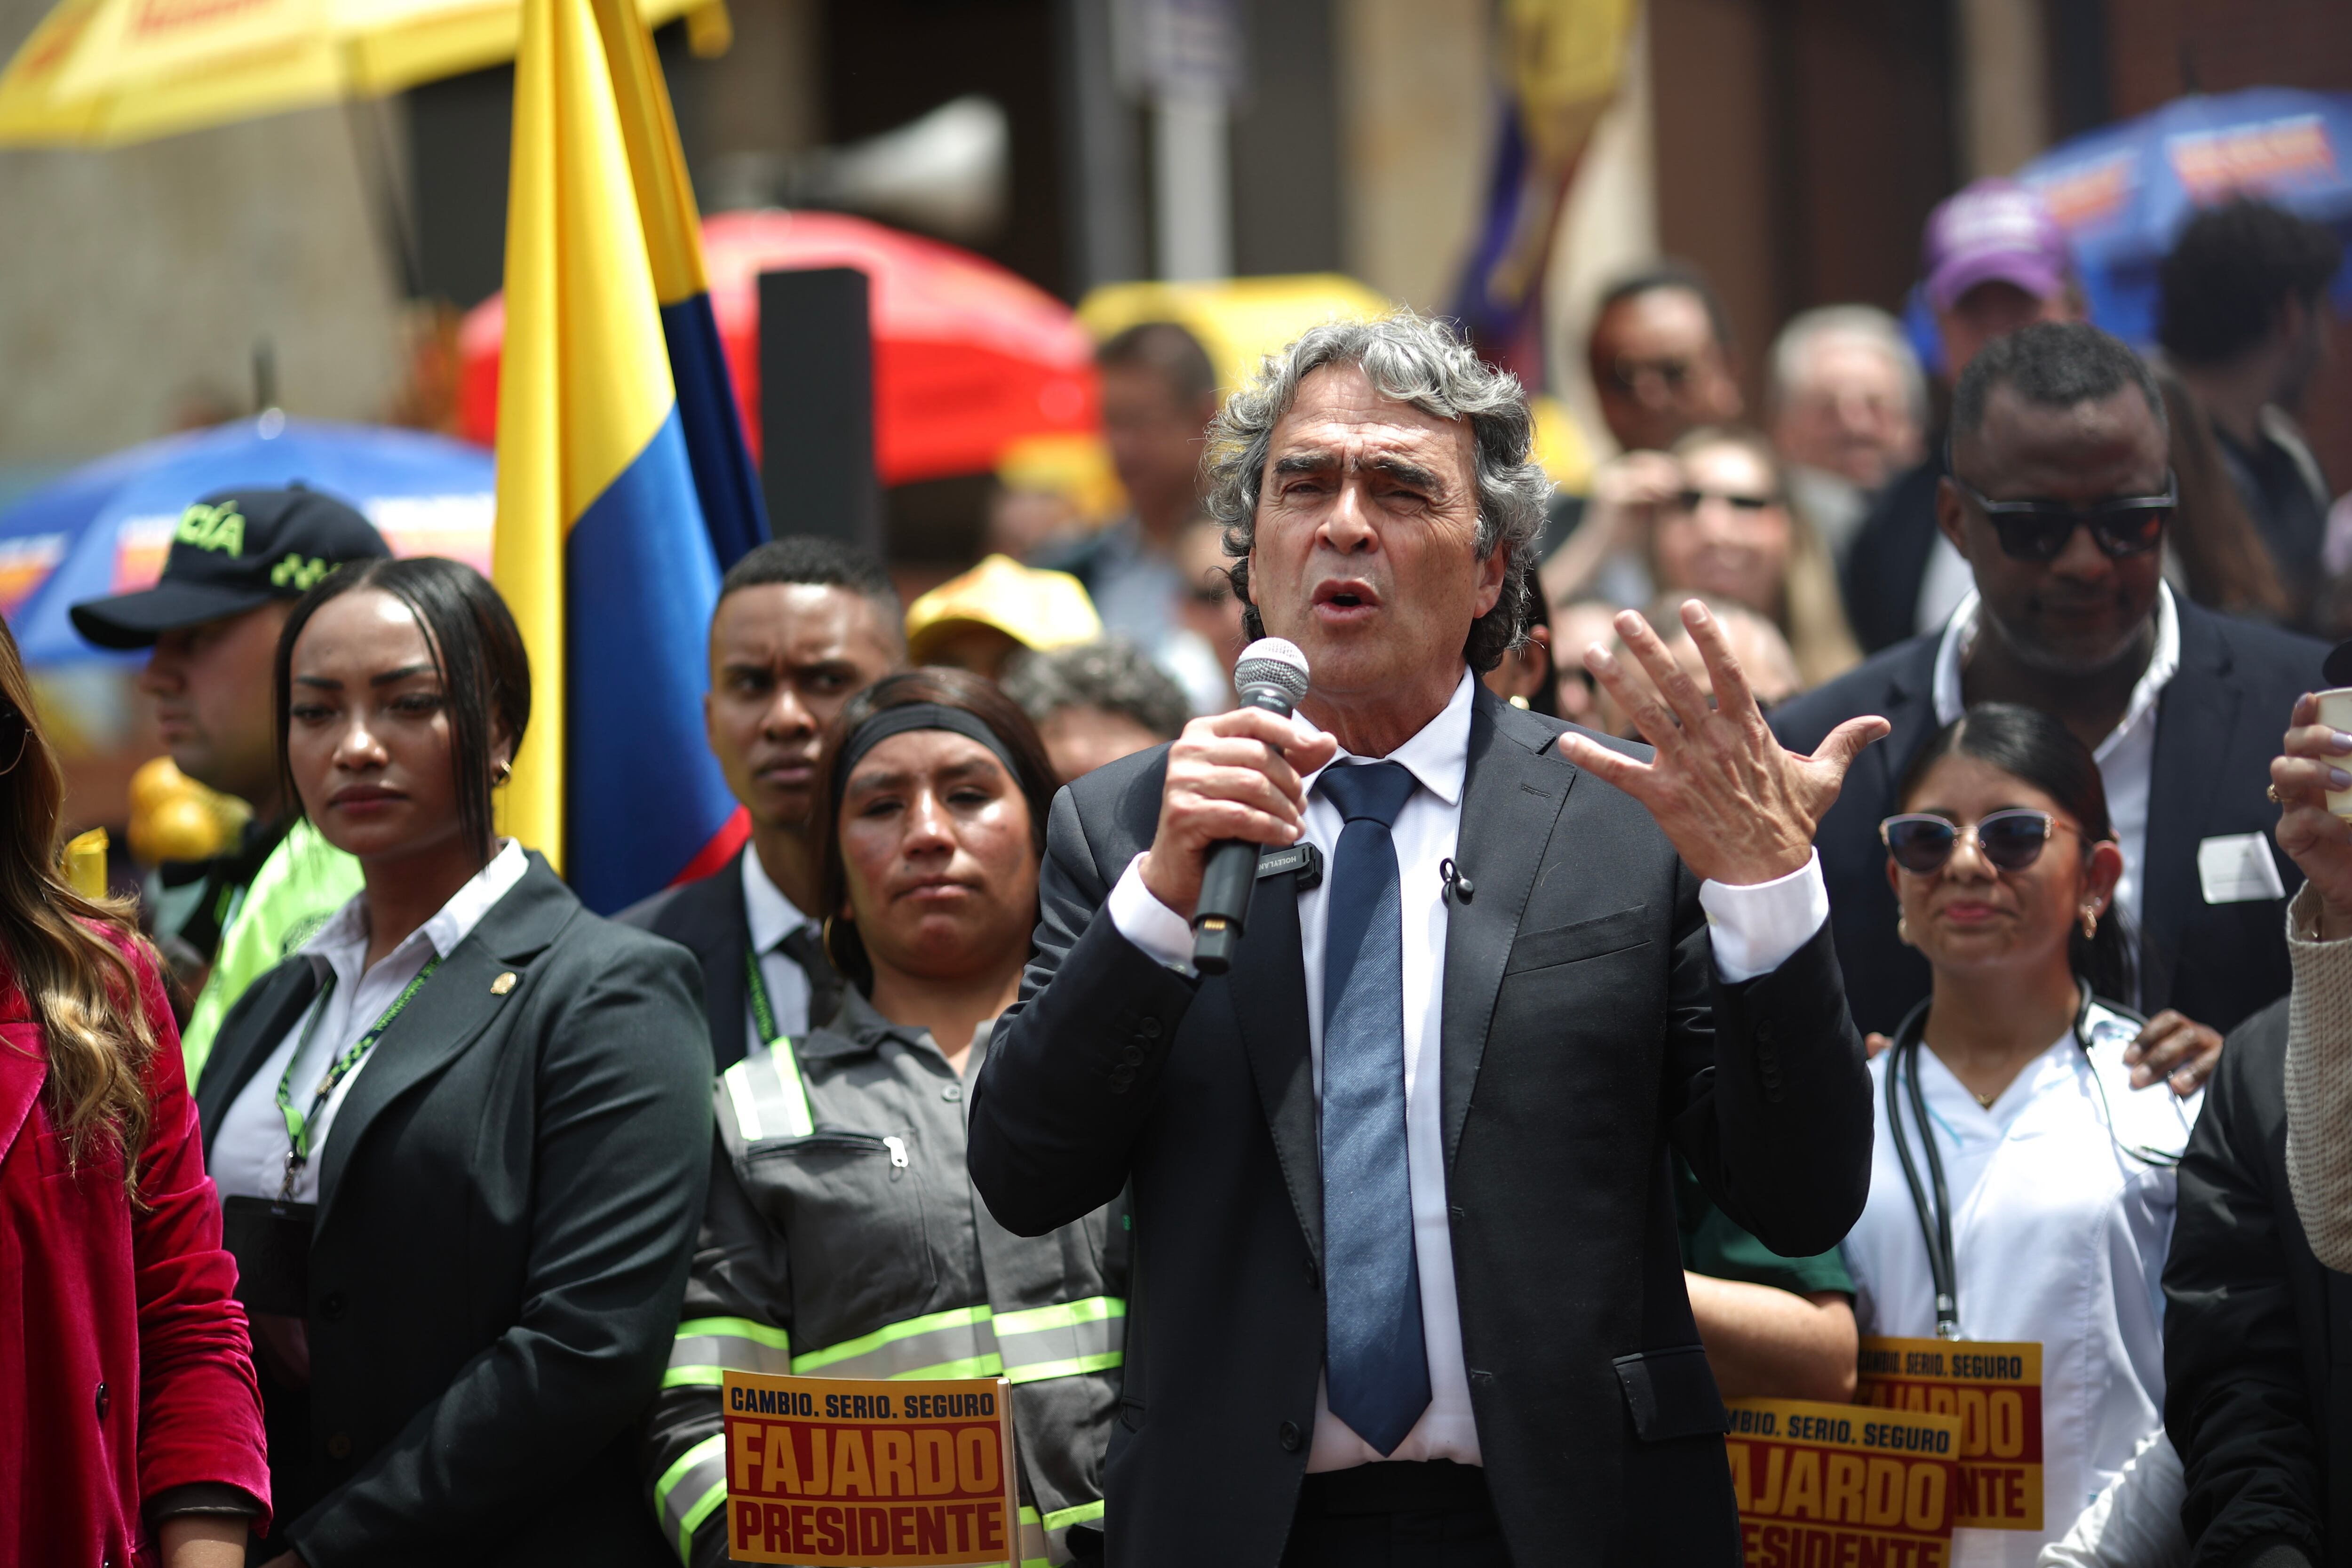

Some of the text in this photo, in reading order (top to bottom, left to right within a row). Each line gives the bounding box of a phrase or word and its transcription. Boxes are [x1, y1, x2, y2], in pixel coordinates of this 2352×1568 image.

[1907, 1353, 1947, 1377] SERIO.
[1952, 1354, 2022, 1380] SEGURO
[731, 1387, 994, 1419] CAMBIO. SERIO. SEGURO
[1788, 1416, 1856, 1445] SERIO.
[1864, 1423, 1950, 1454] SEGURO
[732, 1422, 999, 1496] FAJARDO
[736, 1500, 1004, 1556] PRESIDENTE
